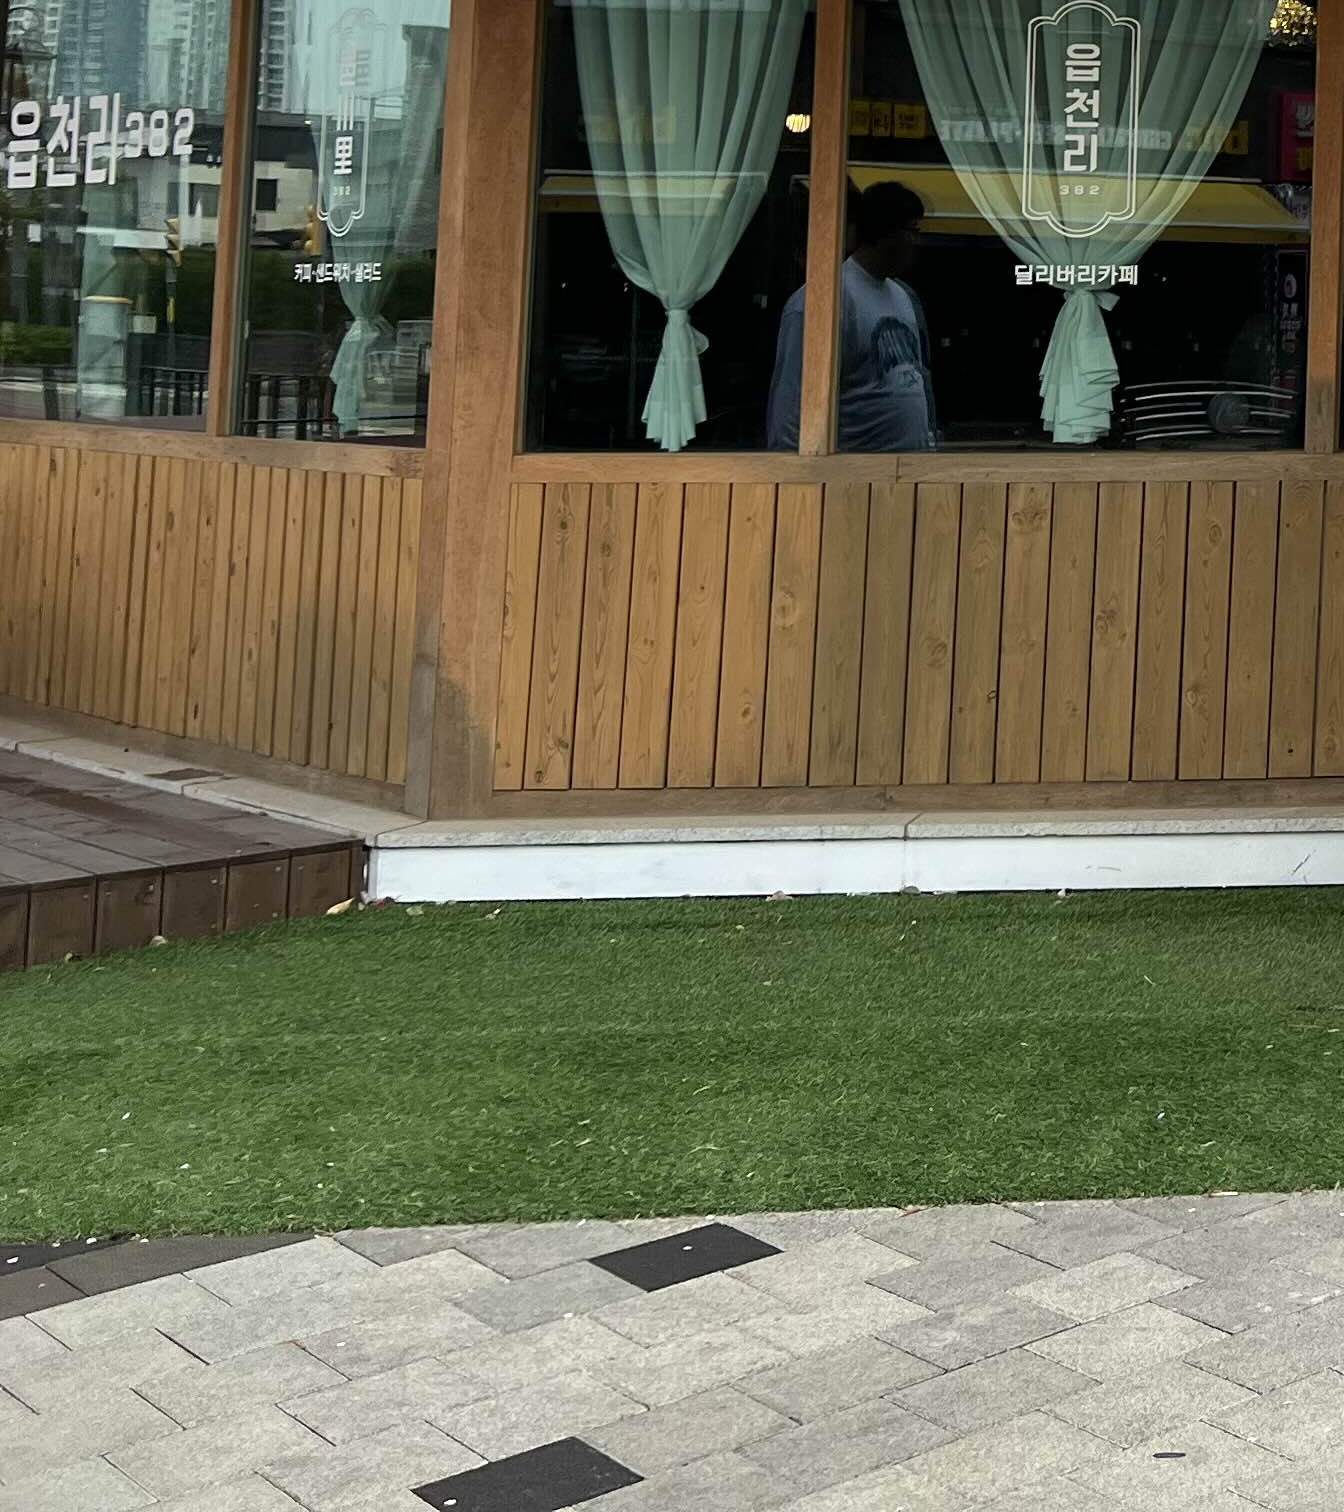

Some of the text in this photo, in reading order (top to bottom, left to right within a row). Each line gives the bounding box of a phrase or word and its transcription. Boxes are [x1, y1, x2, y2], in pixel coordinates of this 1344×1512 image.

[1063, 43, 1102, 173] 읍천리
[1059, 184, 1101, 196] 382
[1014, 264, 1139, 286] 딜리버리카페
